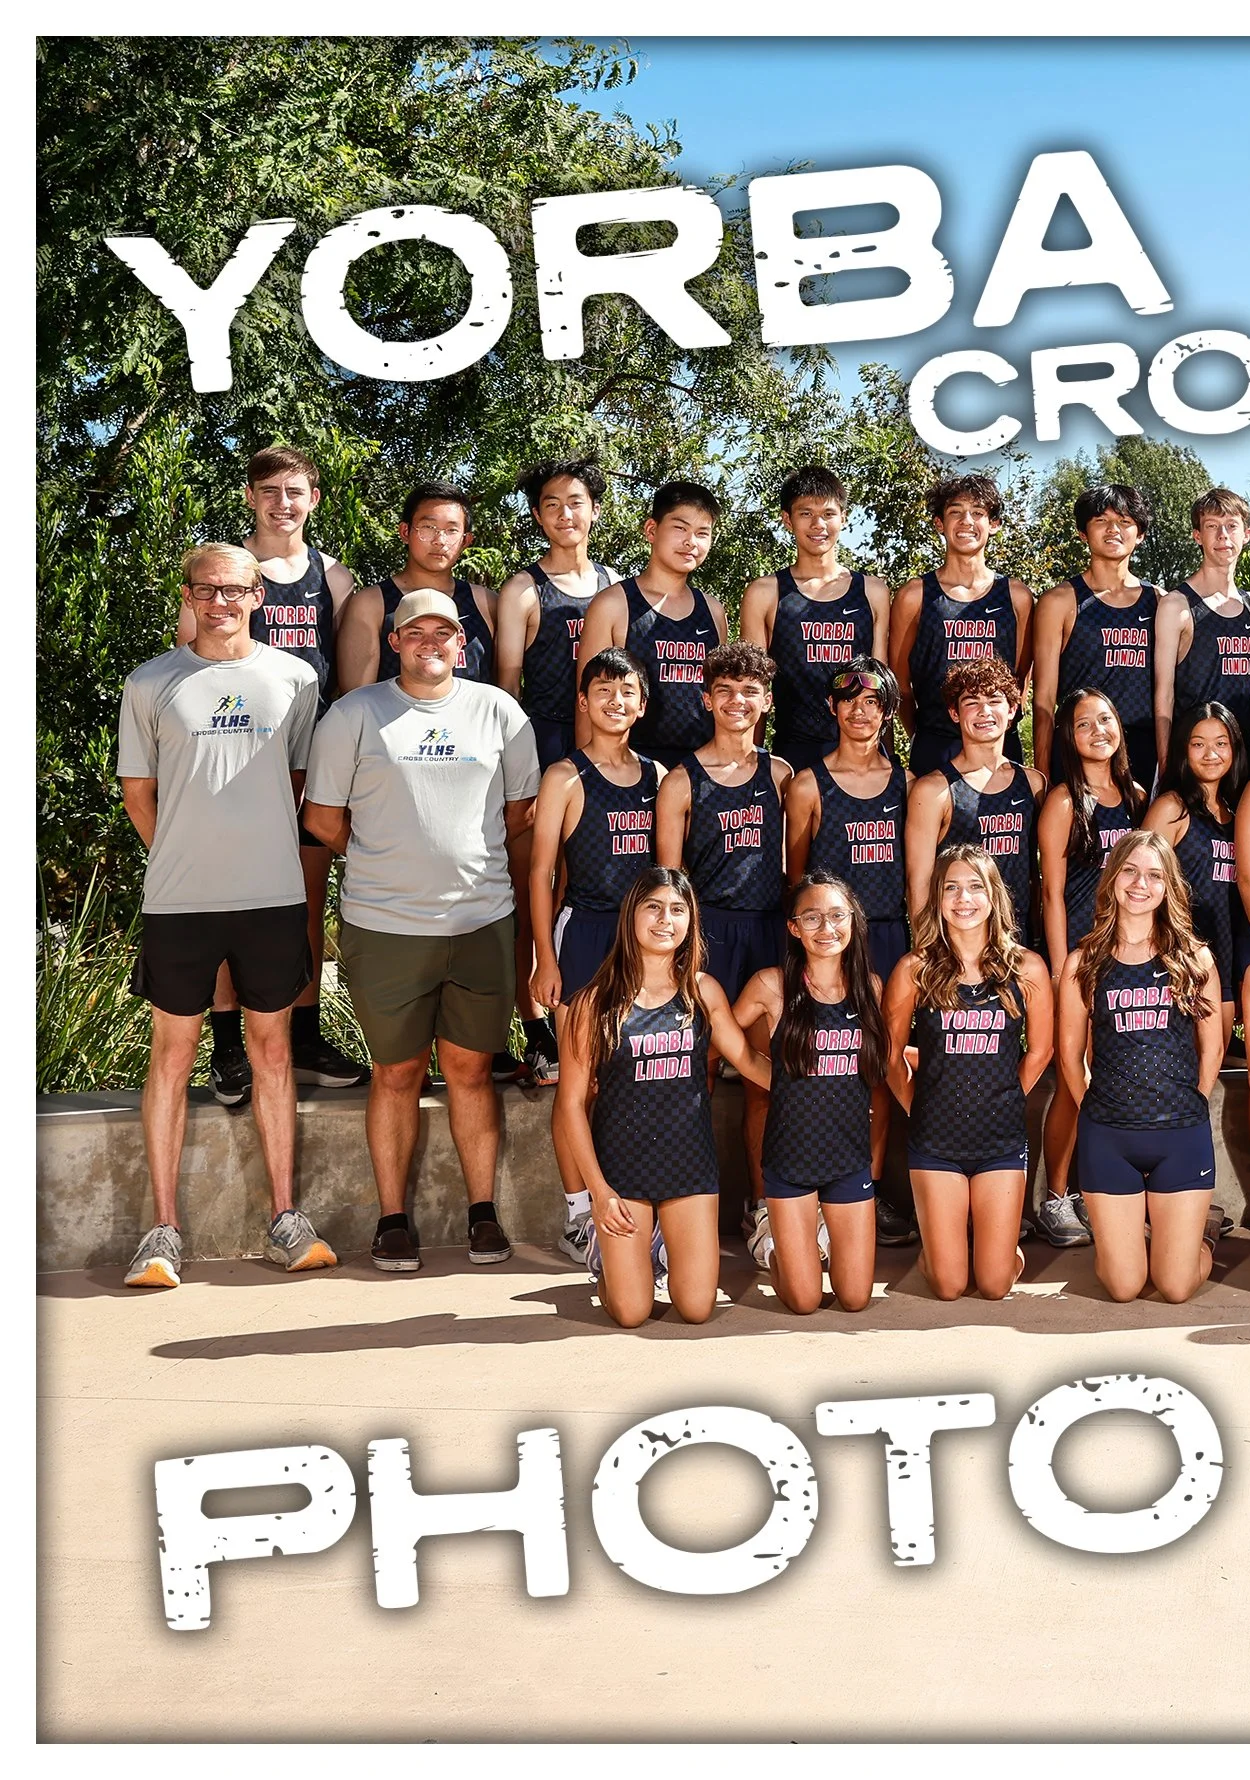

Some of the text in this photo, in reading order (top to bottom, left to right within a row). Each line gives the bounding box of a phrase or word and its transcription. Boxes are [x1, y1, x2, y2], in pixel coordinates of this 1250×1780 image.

[263, 605, 317, 625] YORBA
[269, 629, 317, 648] LINDA
[801, 622, 854, 641] YORBA
[943, 620, 996, 638] YORBA
[1101, 628, 1148, 647] YORBA
[655, 640, 705, 660] YORBA
[806, 644, 853, 663] LINDA
[947, 641, 994, 660] LINDA
[1105, 649, 1146, 668] LINDA
[659, 663, 704, 683] LINDA
[211, 714, 251, 729] YLHS
[418, 744, 456, 756] YLHS
[607, 811, 652, 831] YORBA
[845, 820, 896, 841] YORBA
[978, 812, 1023, 834] YORBA
[851, 843, 894, 864] LINDA
[1211, 839, 1236, 860] YOR
[1212, 862, 1237, 882] LIN
[1106, 986, 1174, 1010] YORBA
[940, 1009, 1006, 1030] YORBA
[1114, 1009, 1169, 1033] LINDA
[629, 1028, 694, 1058] YORBA
[814, 1028, 862, 1050] ORBA
[945, 1033, 1000, 1054] LINDA
[634, 1055, 691, 1082] LINDA
[807, 1054, 858, 1077] INDA
